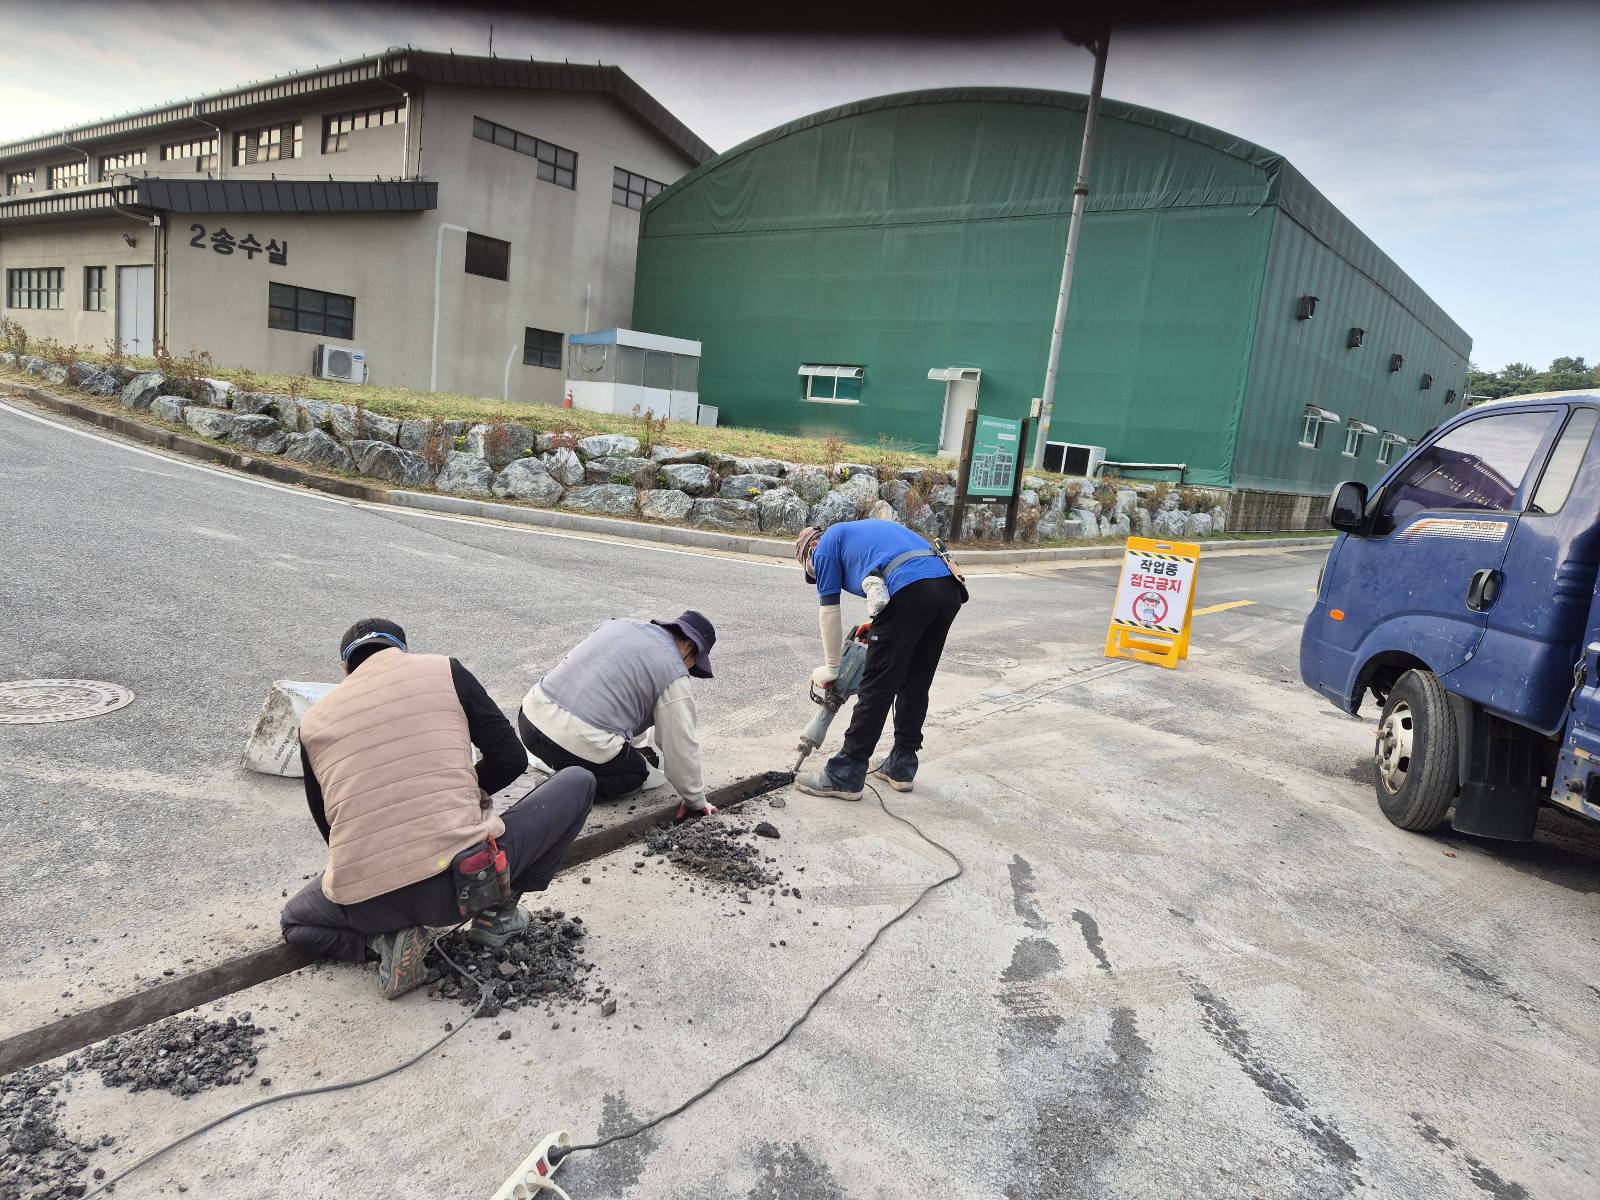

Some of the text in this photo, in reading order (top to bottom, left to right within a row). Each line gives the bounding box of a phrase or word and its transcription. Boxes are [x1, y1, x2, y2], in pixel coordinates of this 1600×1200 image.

[190, 223, 288, 267] 2송수실
[1462, 521, 1496, 531] BONGO
[1140, 559, 1178, 576] 작업중
[1130, 574, 1182, 593] 접근금지
